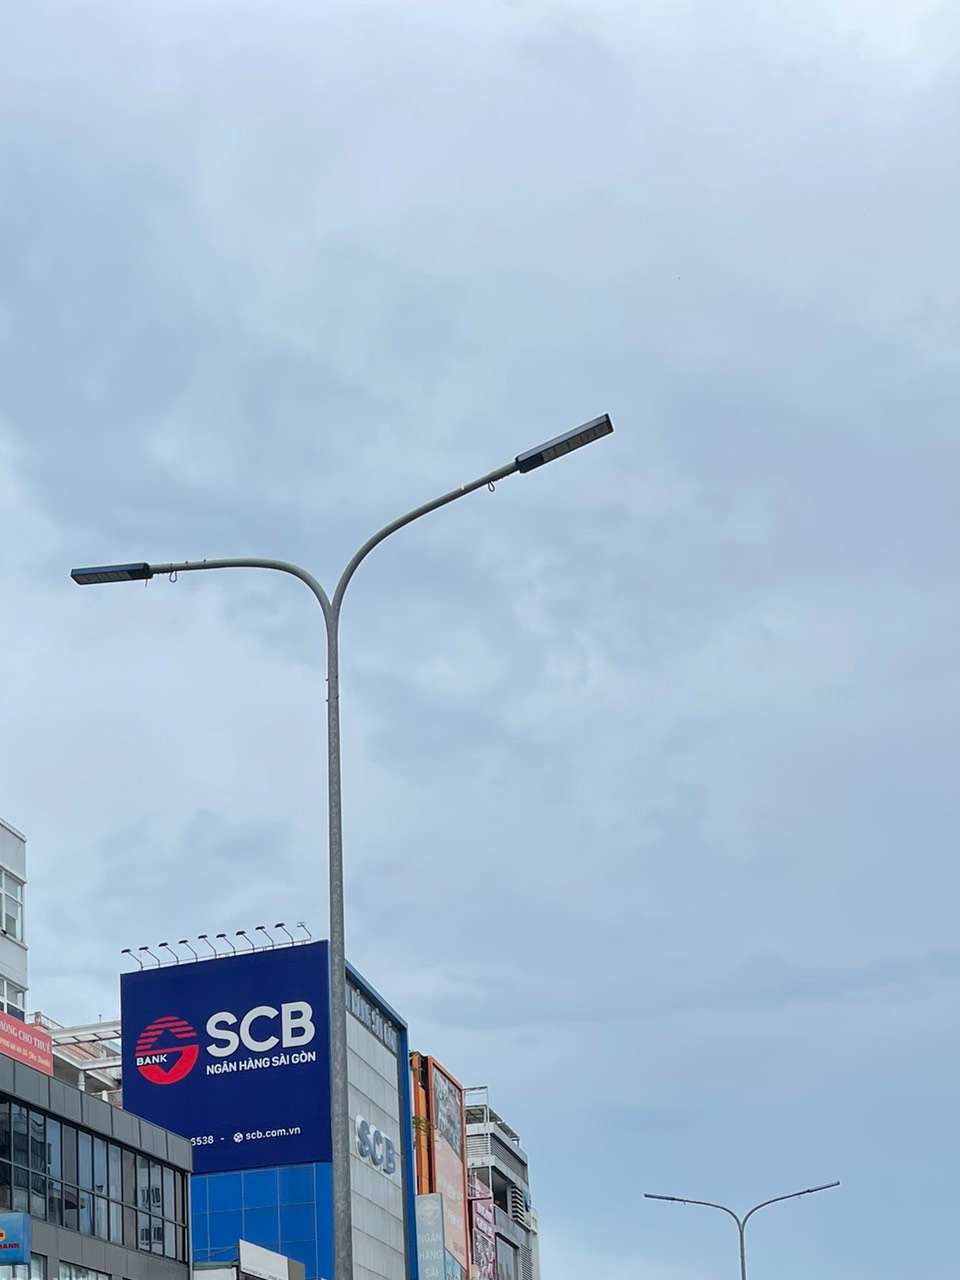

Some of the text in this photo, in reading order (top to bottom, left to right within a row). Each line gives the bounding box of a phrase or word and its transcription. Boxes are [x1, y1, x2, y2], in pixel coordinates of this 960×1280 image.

[205, 1001, 316, 1058] SCB
[136, 1054, 168, 1066] BANK
[206, 1051, 316, 1075] NGÂN HÀNG SÀI GÒN
[246, 1127, 301, 1140] scb.com.vn
